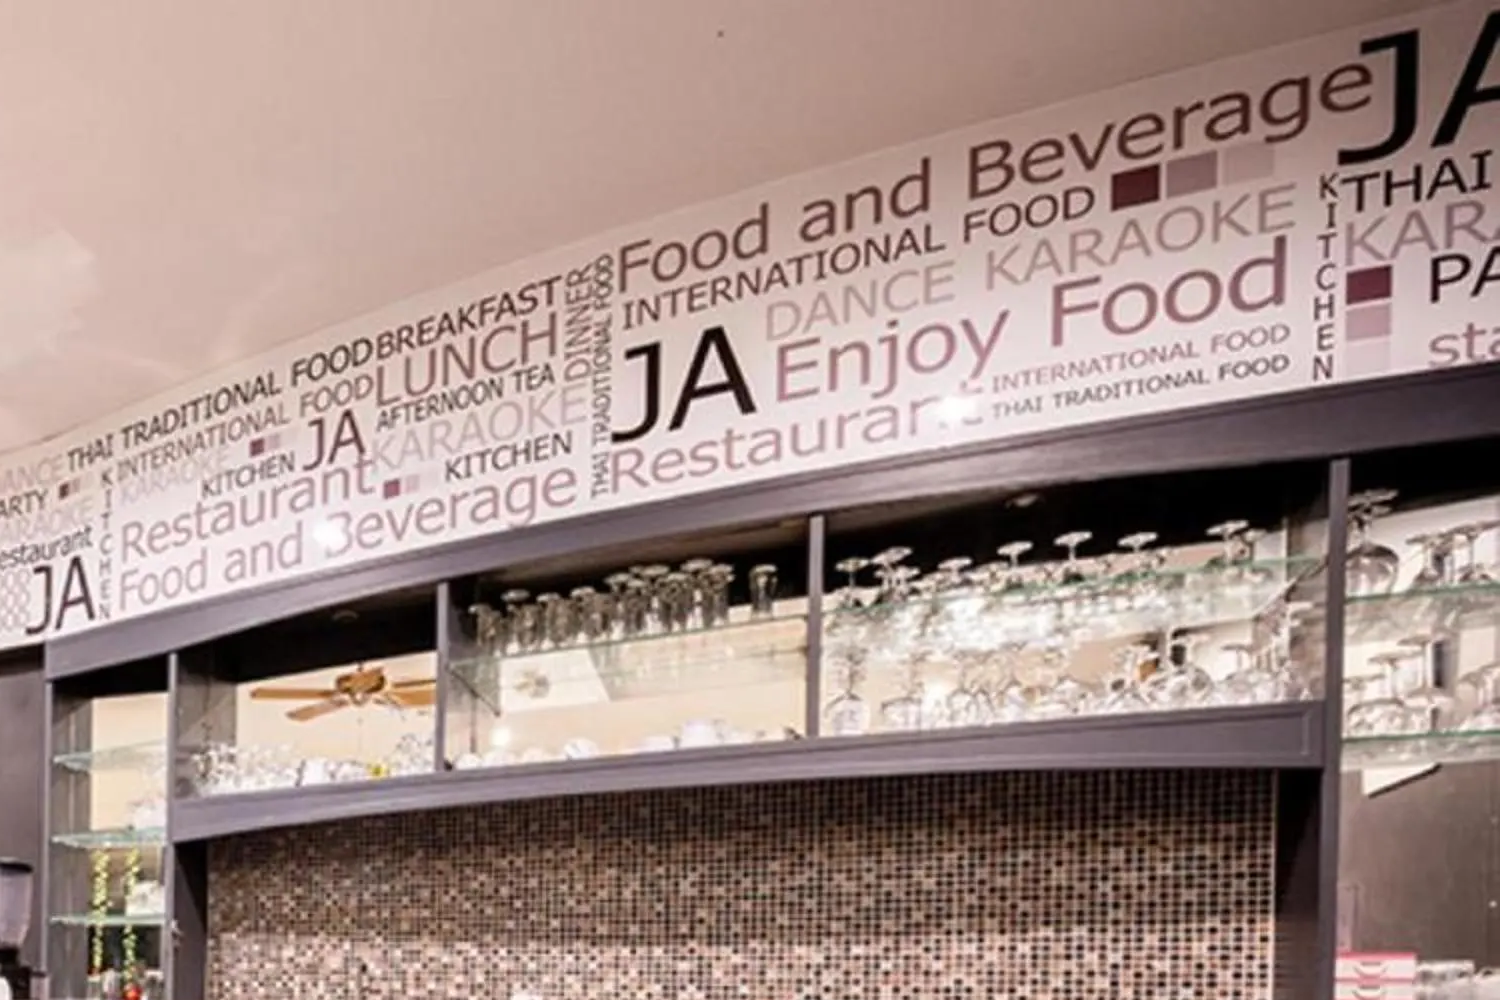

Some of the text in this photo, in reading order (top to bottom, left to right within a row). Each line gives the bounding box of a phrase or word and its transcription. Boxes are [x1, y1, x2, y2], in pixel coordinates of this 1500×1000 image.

[619, 61, 1373, 294] Food and Beverage
[1342, 150, 1492, 213] THAI
[622, 186, 1095, 331] INTERNATIONAL FOOD
[766, 183, 1297, 342] DANCE KARAOKE
[1312, 172, 1339, 381] KITCHEN
[1346, 200, 1500, 266] KAR
[377, 275, 563, 360] BREAKFAST
[377, 311, 557, 407] LUNCH
[564, 262, 595, 383] DINNER
[777, 234, 1287, 402] Enjoy Food
[993, 323, 1291, 393] INTERNATIONAL FOOD
[67, 337, 374, 472] THAI TRADITIONAL FOOD
[117, 373, 374, 482] INTERNATIONAL FOOD
[371, 388, 587, 472] KARAOKE
[375, 363, 555, 433] AFTERNOON TEA
[611, 325, 756, 444] JA
[993, 353, 1290, 418] THAI TRADITIONAL FOOD
[202, 452, 295, 498] KITCHEN
[303, 408, 366, 471] JA
[445, 431, 573, 482] KITCHEN
[98, 468, 112, 620] KITCHEN
[121, 457, 375, 562] Restaurant
[26, 555, 96, 635] JA
[120, 556, 208, 611] Food
[225, 521, 303, 582] and
